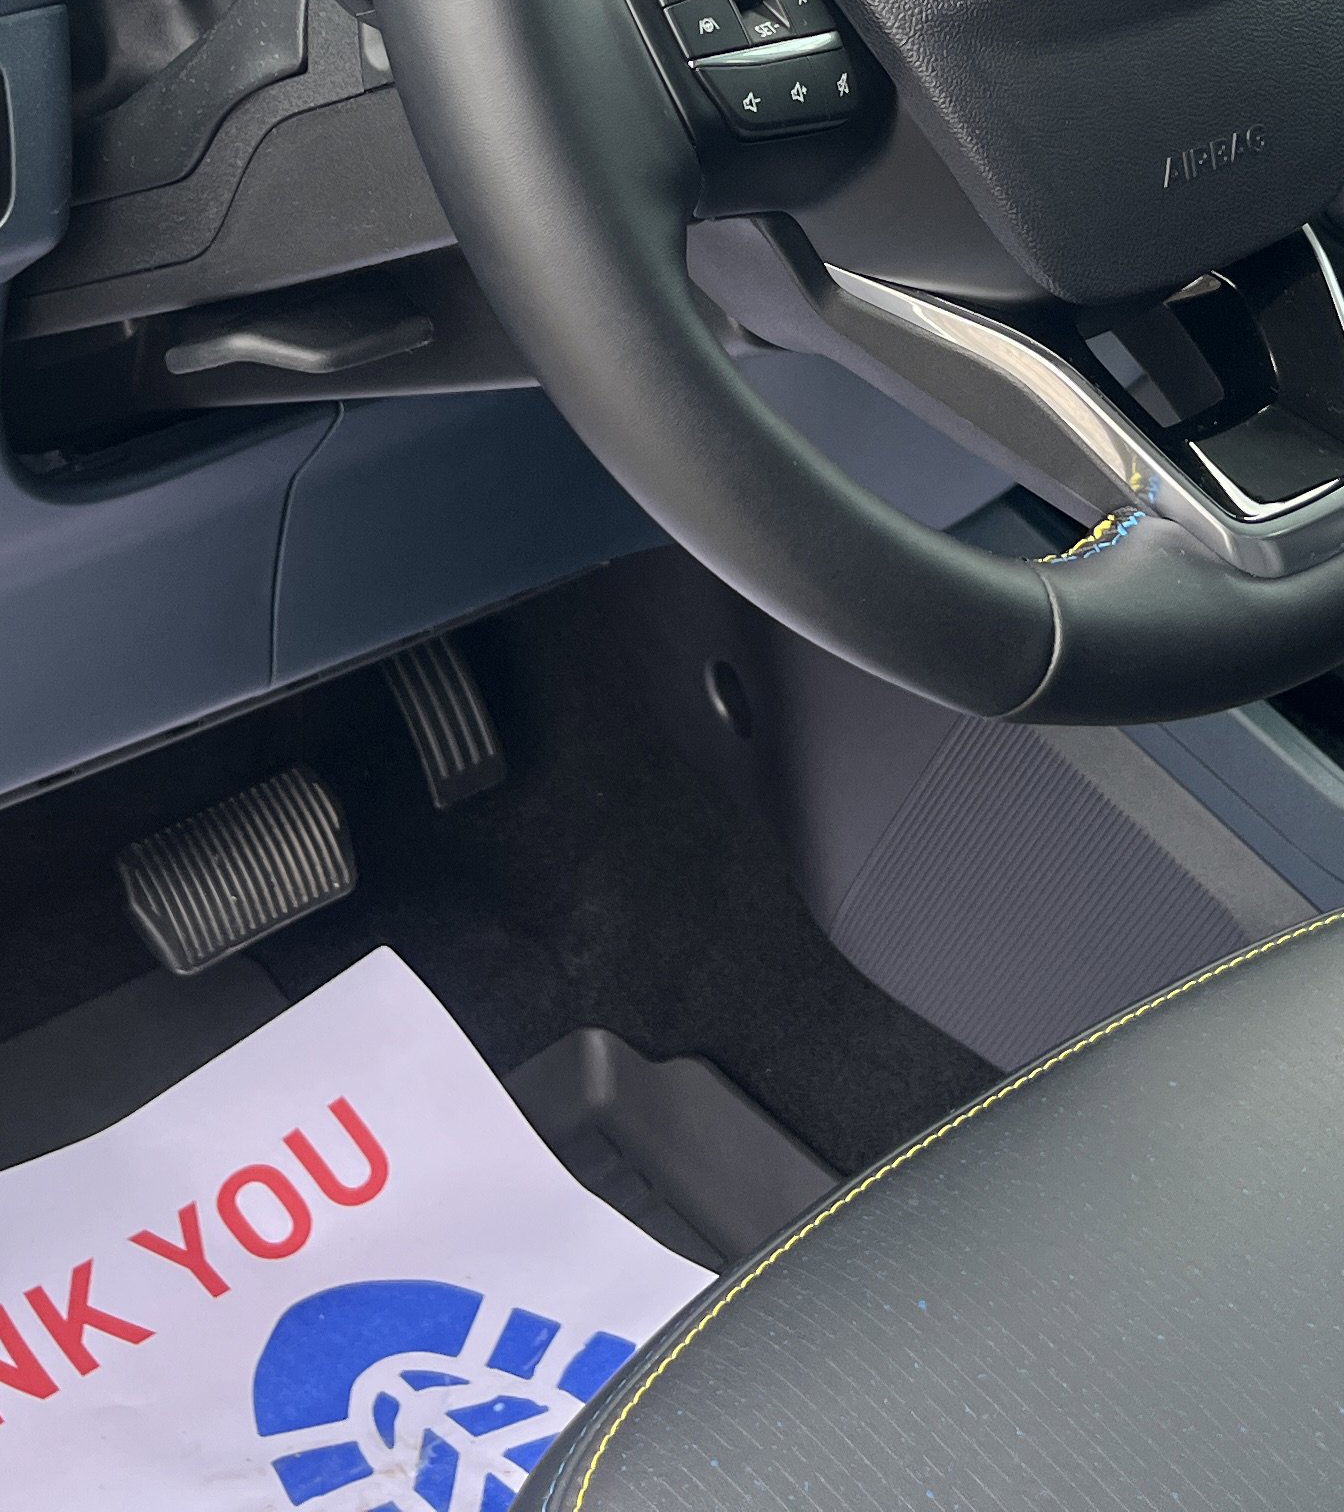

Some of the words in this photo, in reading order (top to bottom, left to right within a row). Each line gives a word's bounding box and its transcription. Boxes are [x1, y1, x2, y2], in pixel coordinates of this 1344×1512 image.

[754, 21, 780, 38] SET-
[1162, 123, 1267, 189] AIRBAG
[128, 1095, 390, 1299] YOU
